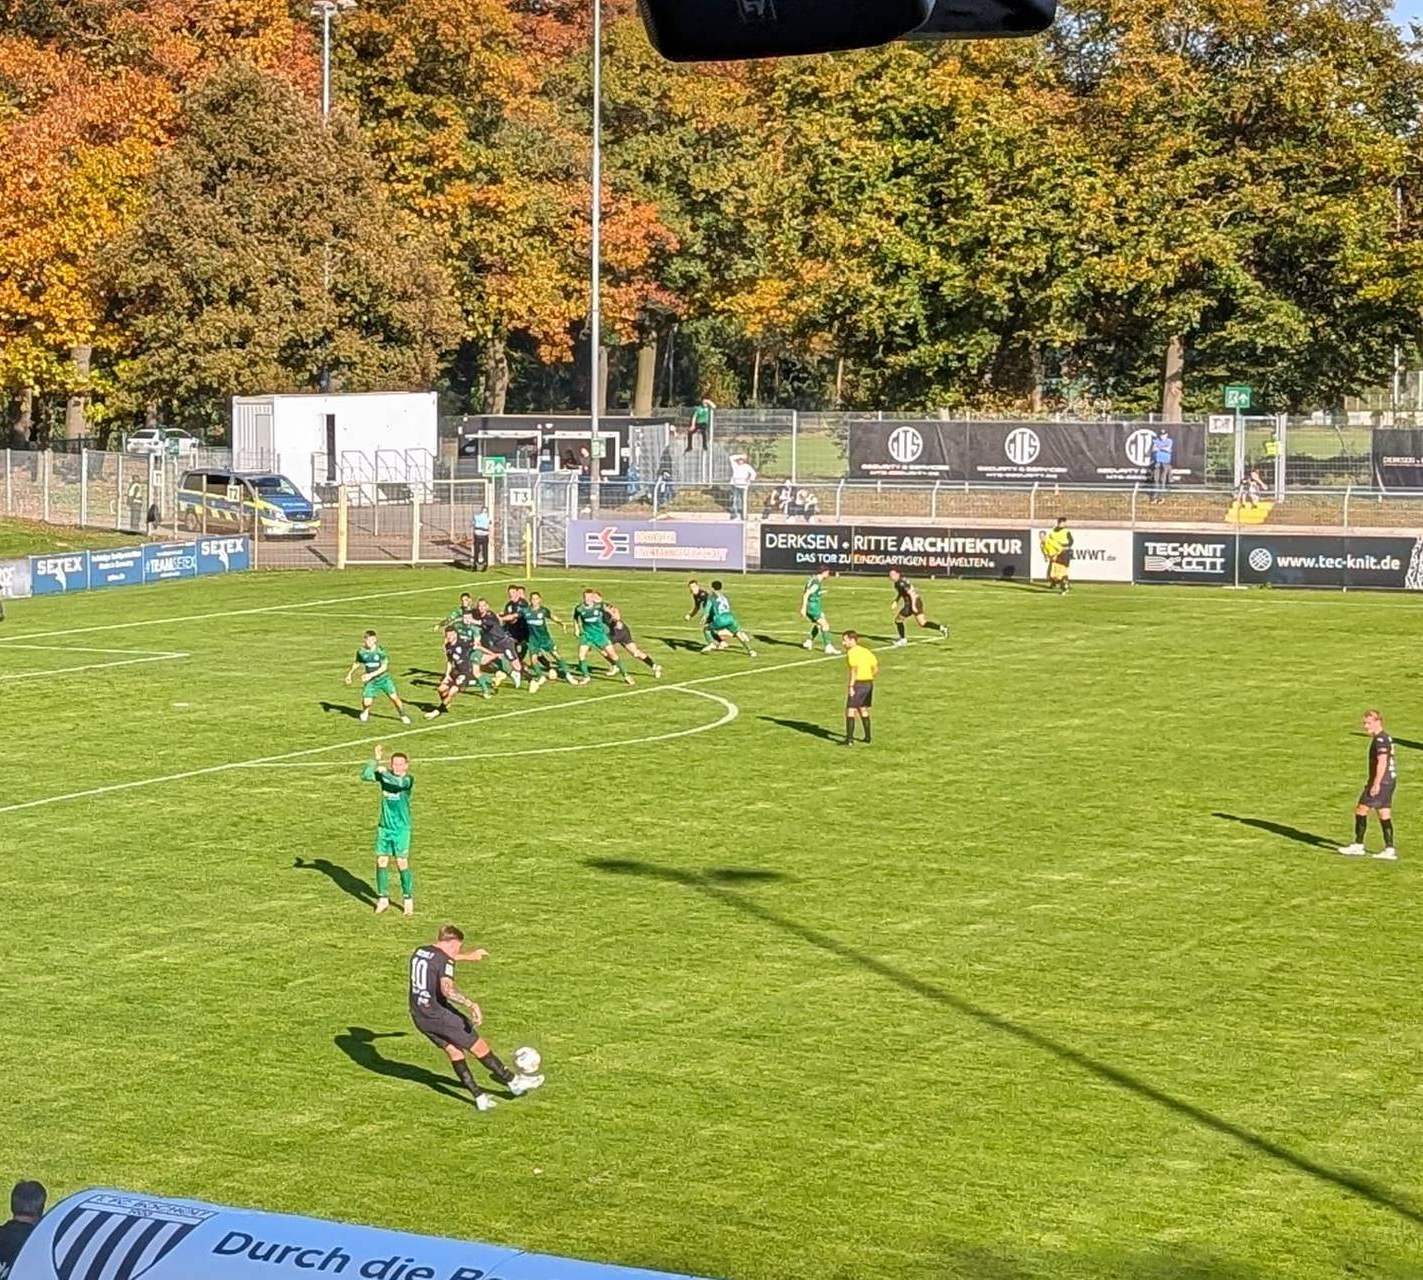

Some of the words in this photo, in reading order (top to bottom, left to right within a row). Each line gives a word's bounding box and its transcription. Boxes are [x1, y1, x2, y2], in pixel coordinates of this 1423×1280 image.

[229, 487, 239, 500] T2
[513, 491, 529, 503] T3
[200, 538, 244, 556] SETEX
[765, 533, 838, 550] DERKSEN
[854, 535, 898, 551] RITTE
[900, 536, 1023, 554] ARCHITEKTUR
[1144, 542, 1226, 557] TEC-KNIT
[37, 556, 83, 577] SETEX
[796, 553, 816, 563] DAS
[818, 553, 838, 563] TOR
[838, 554, 852, 564] ZU
[854, 554, 927, 566] EINZIGARTIGEN
[1277, 554, 1401, 570] www.tec-knit.de
[411, 956, 428, 990] 10
[212, 1230, 351, 1274] Durch
[359, 1254, 435, 1280] die
